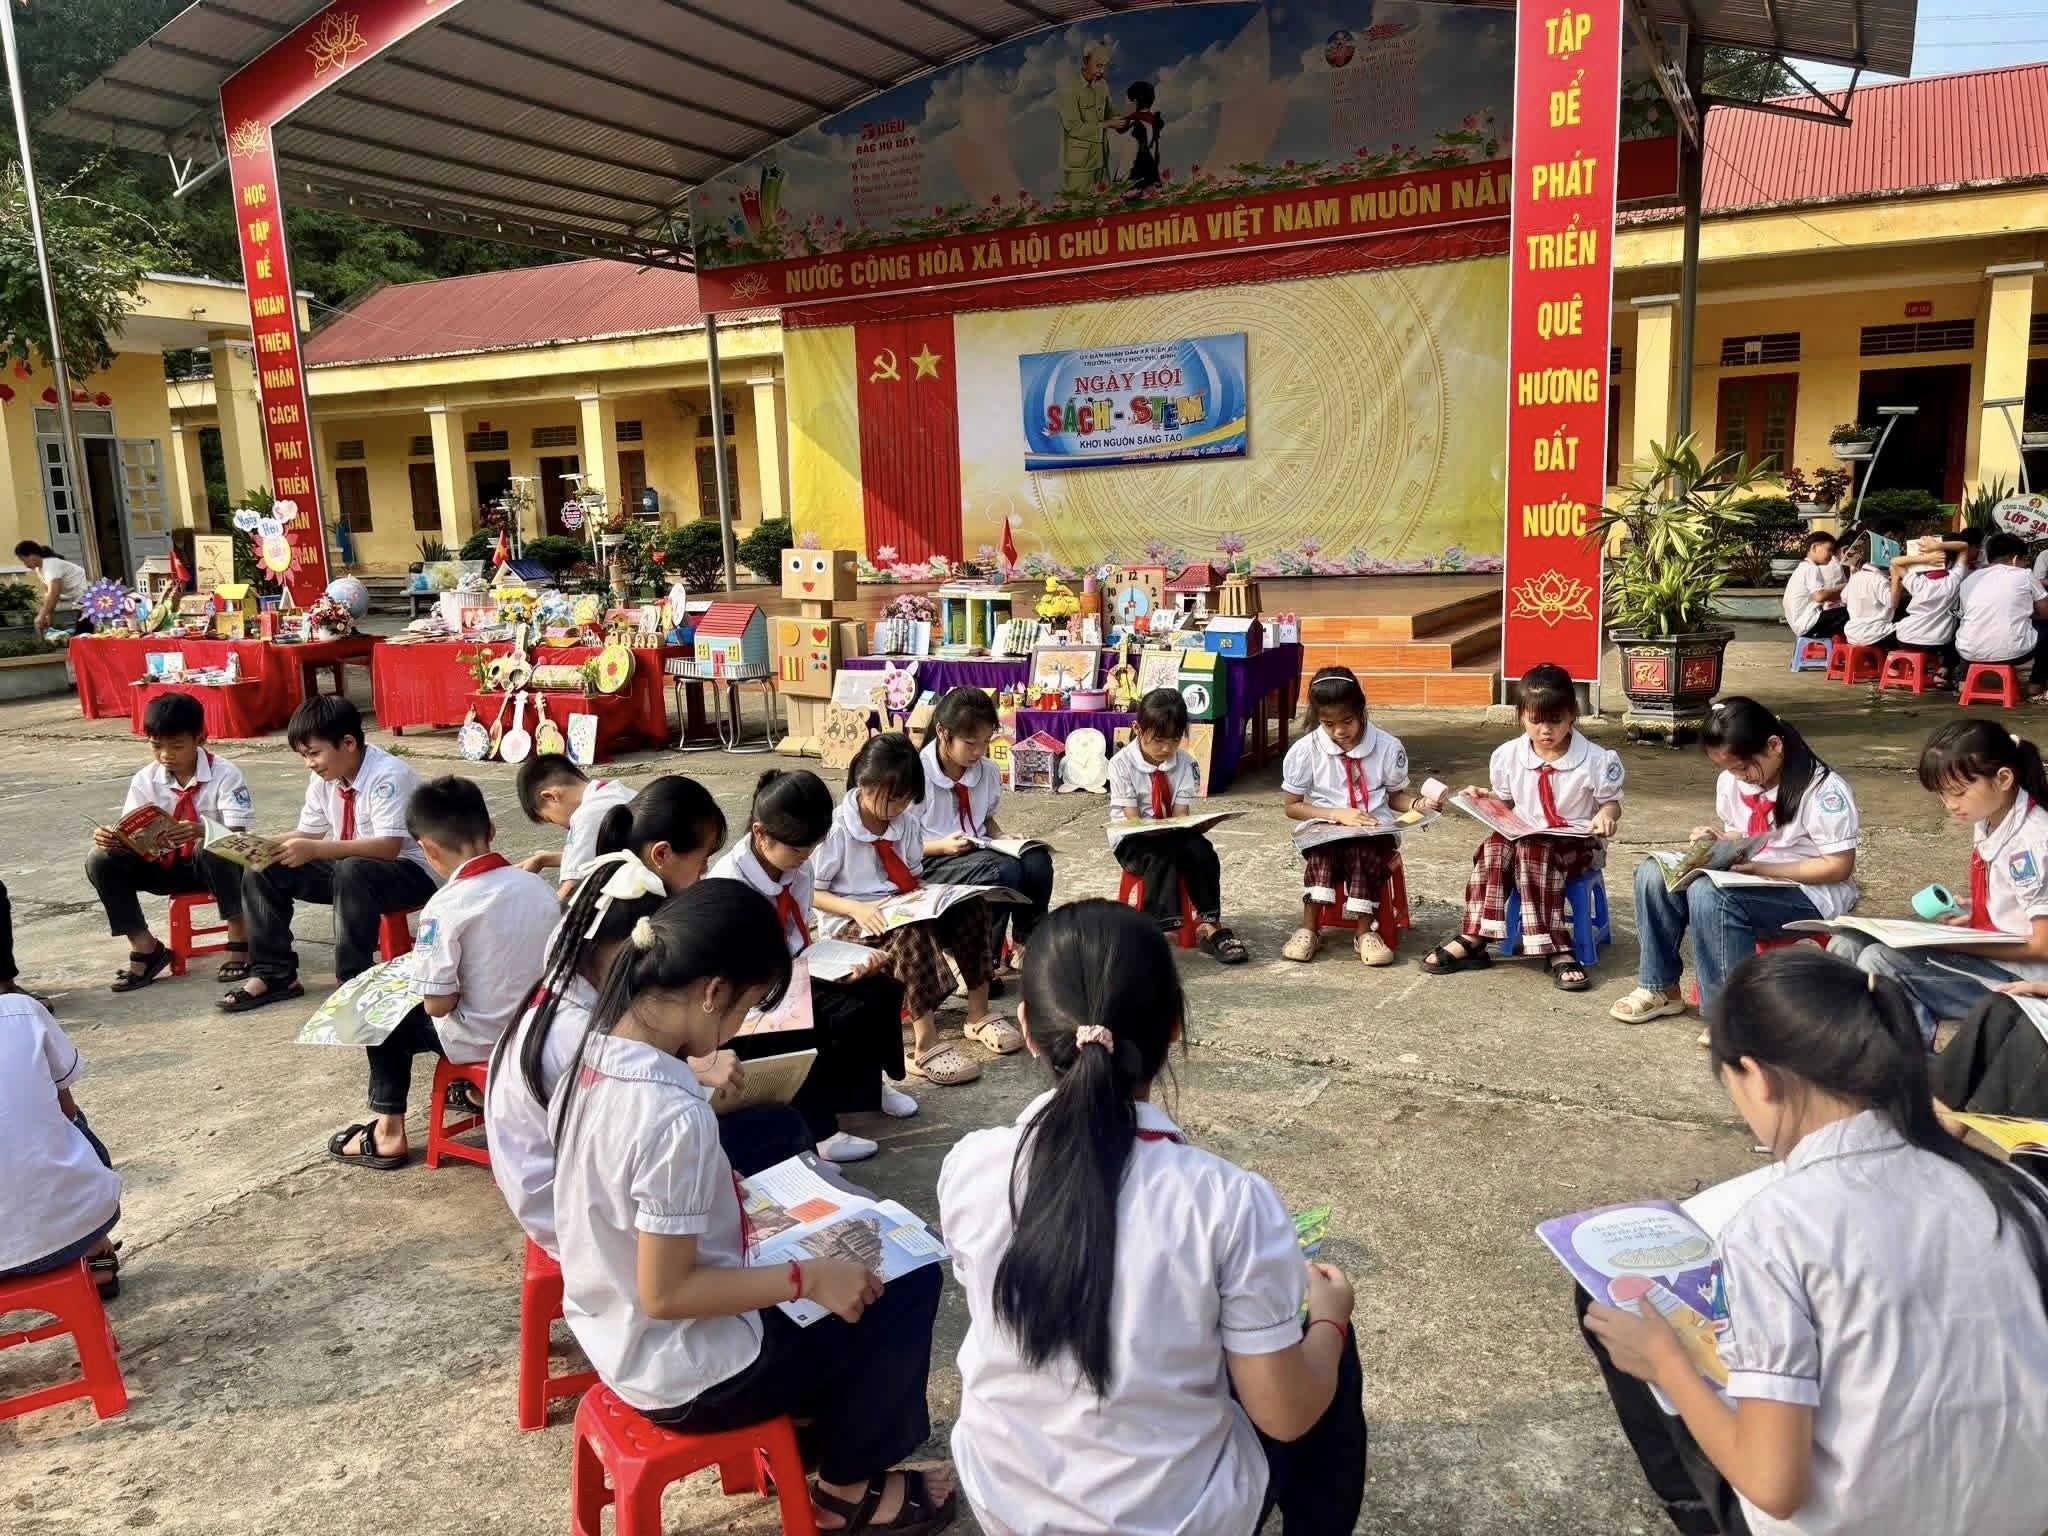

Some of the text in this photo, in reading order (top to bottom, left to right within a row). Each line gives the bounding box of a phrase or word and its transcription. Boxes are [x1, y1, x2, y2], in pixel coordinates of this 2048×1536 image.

[1545, 13, 1592, 60] TẬP
[1549, 69, 1586, 128] ĐỂ
[1532, 151, 1597, 201] PHÁT
[243, 183, 267, 208] HỌC
[248, 218, 270, 247] TẬP
[785, 259, 844, 294] NƯỚC
[851, 255, 911, 289] CỘNG
[918, 243, 964, 277] HÒA
[972, 238, 1004, 271] XÃ
[1010, 231, 1051, 269] HỘI
[1059, 217, 1109, 260] CHỦ
[1117, 212, 1200, 251] NGHĨA
[1206, 203, 1265, 243] VIỆT
[1273, 198, 1340, 233] NAM
[1350, 180, 1441, 224] MUÔN
[1527, 212, 1597, 270] TRIỂN
[253, 291, 286, 317] HOÀN
[1537, 295, 1583, 342] QUÊ
[257, 328, 292, 356] THIỆN
[263, 364, 296, 389] NHÂN
[1074, 364, 1183, 393] NGÀY HỘI
[1518, 367, 1599, 407] HƯƠNG
[269, 401, 300, 425] CÁCH
[1047, 397, 1112, 435] SÁCH
[1130, 394, 1205, 431] STEM
[274, 435, 303, 461] PHÁT
[1137, 433, 1162, 444] SÁNG
[1533, 424, 1579, 472] ĐẤT
[277, 466, 311, 495] TRIỂN
[1522, 494, 1587, 538] NƯỚC
[2003, 511, 2029, 525] LỚP
[2031, 519, 2048, 534] 3A
[298, 543, 319, 565] ÂN
[1128, 569, 1138, 581] 12
[1106, 587, 1117, 598] 10
